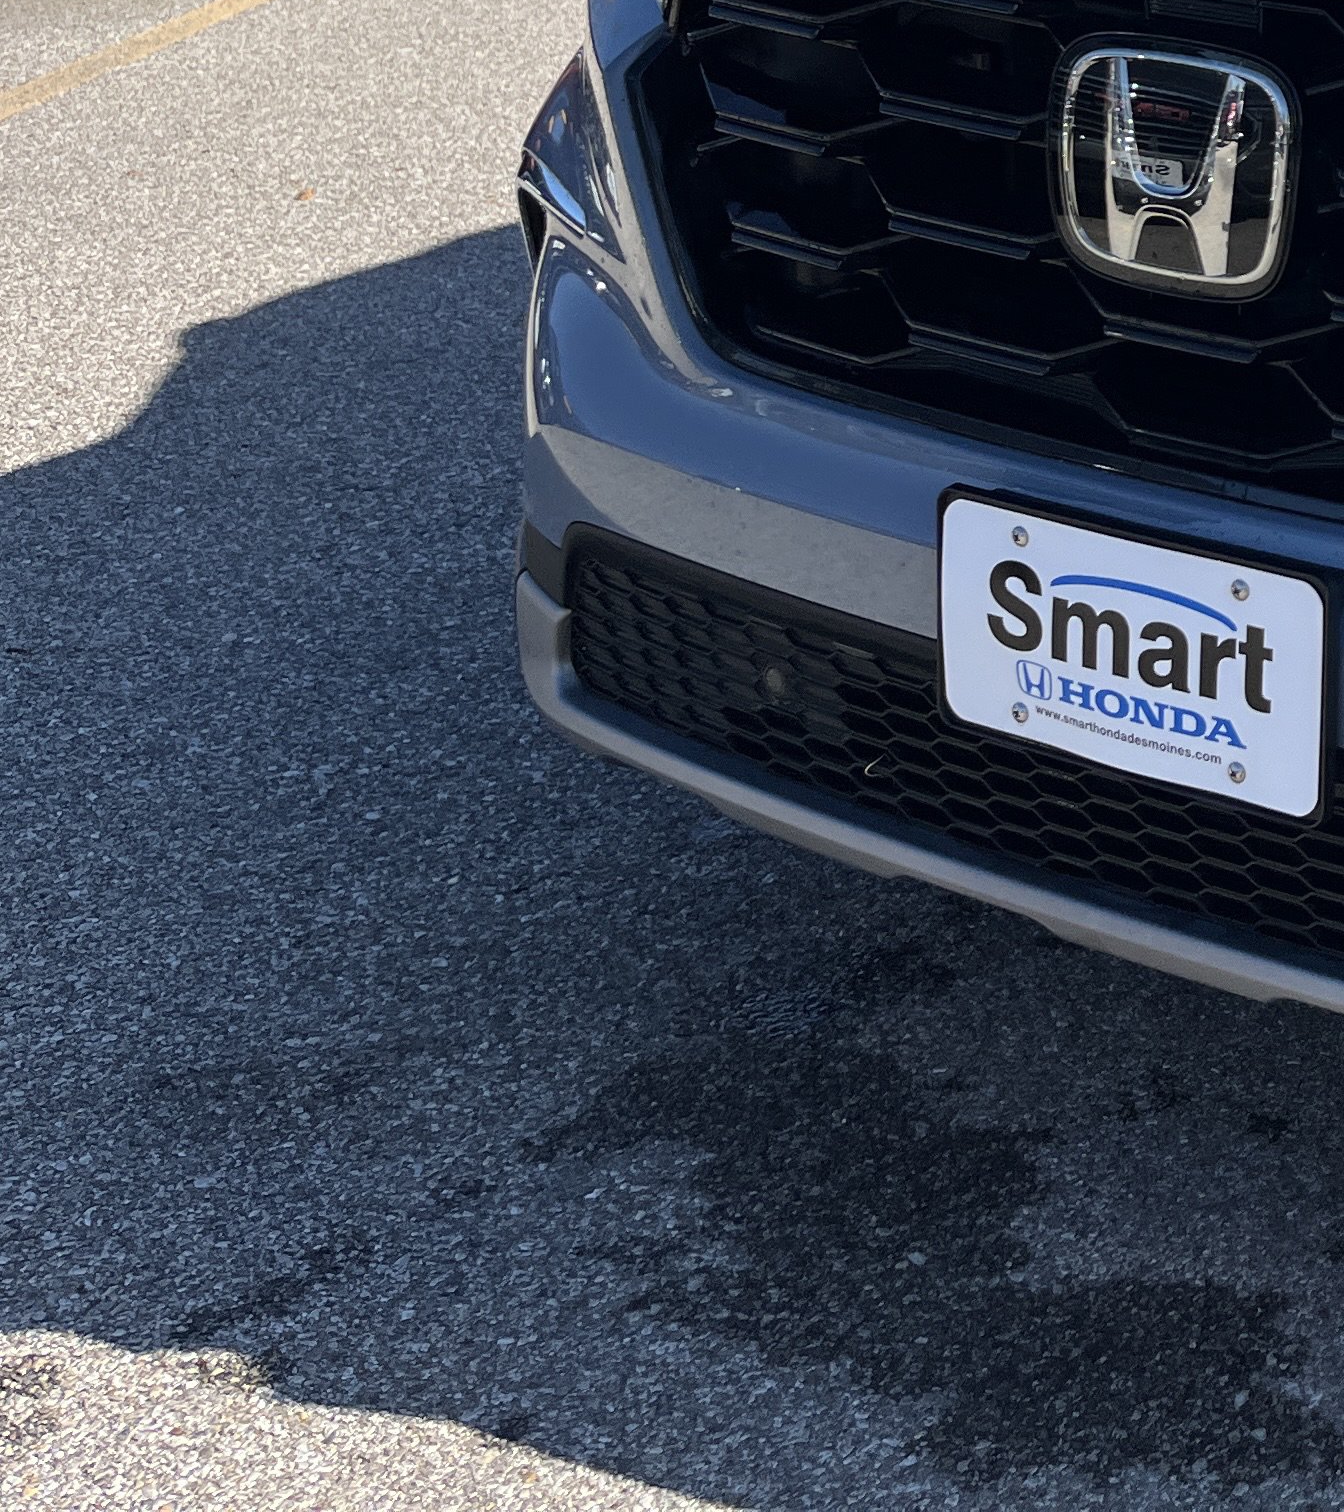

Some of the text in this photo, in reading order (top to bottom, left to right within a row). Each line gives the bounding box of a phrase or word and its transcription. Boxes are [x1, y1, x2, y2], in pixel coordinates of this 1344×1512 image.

[987, 559, 1274, 714] Smart
[1035, 703, 1222, 765] www.smarthondadesmoines.com
[1058, 675, 1247, 750] HONDA
